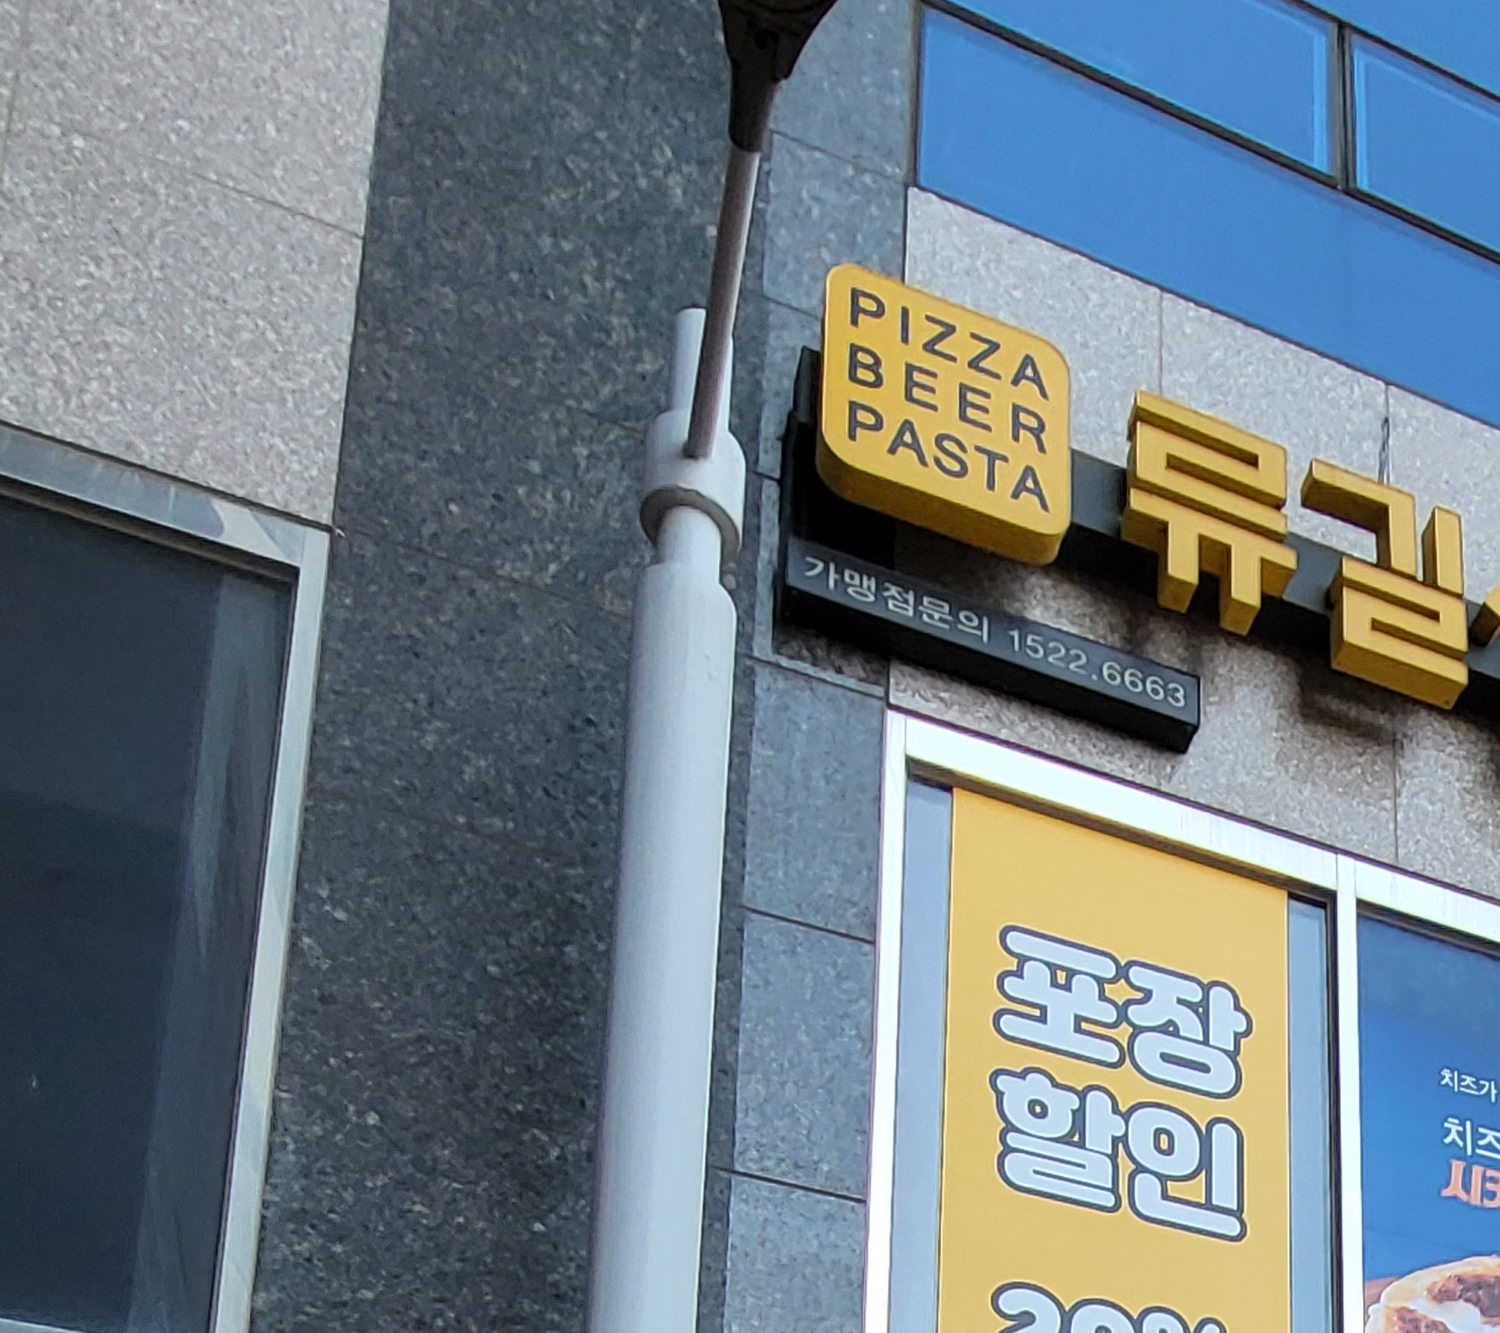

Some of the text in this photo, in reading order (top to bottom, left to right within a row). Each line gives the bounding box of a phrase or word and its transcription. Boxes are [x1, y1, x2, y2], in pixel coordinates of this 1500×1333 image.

[848, 285, 1050, 401] PIZZA
[848, 342, 1048, 454] BEER
[847, 400, 1051, 514] PASTA
[803, 555, 1188, 709] 가맹점문의 1522.6663
[992, 924, 1254, 1099] 포장
[1439, 1067, 1499, 1104] 치즈가
[989, 1066, 1248, 1242] 할인
